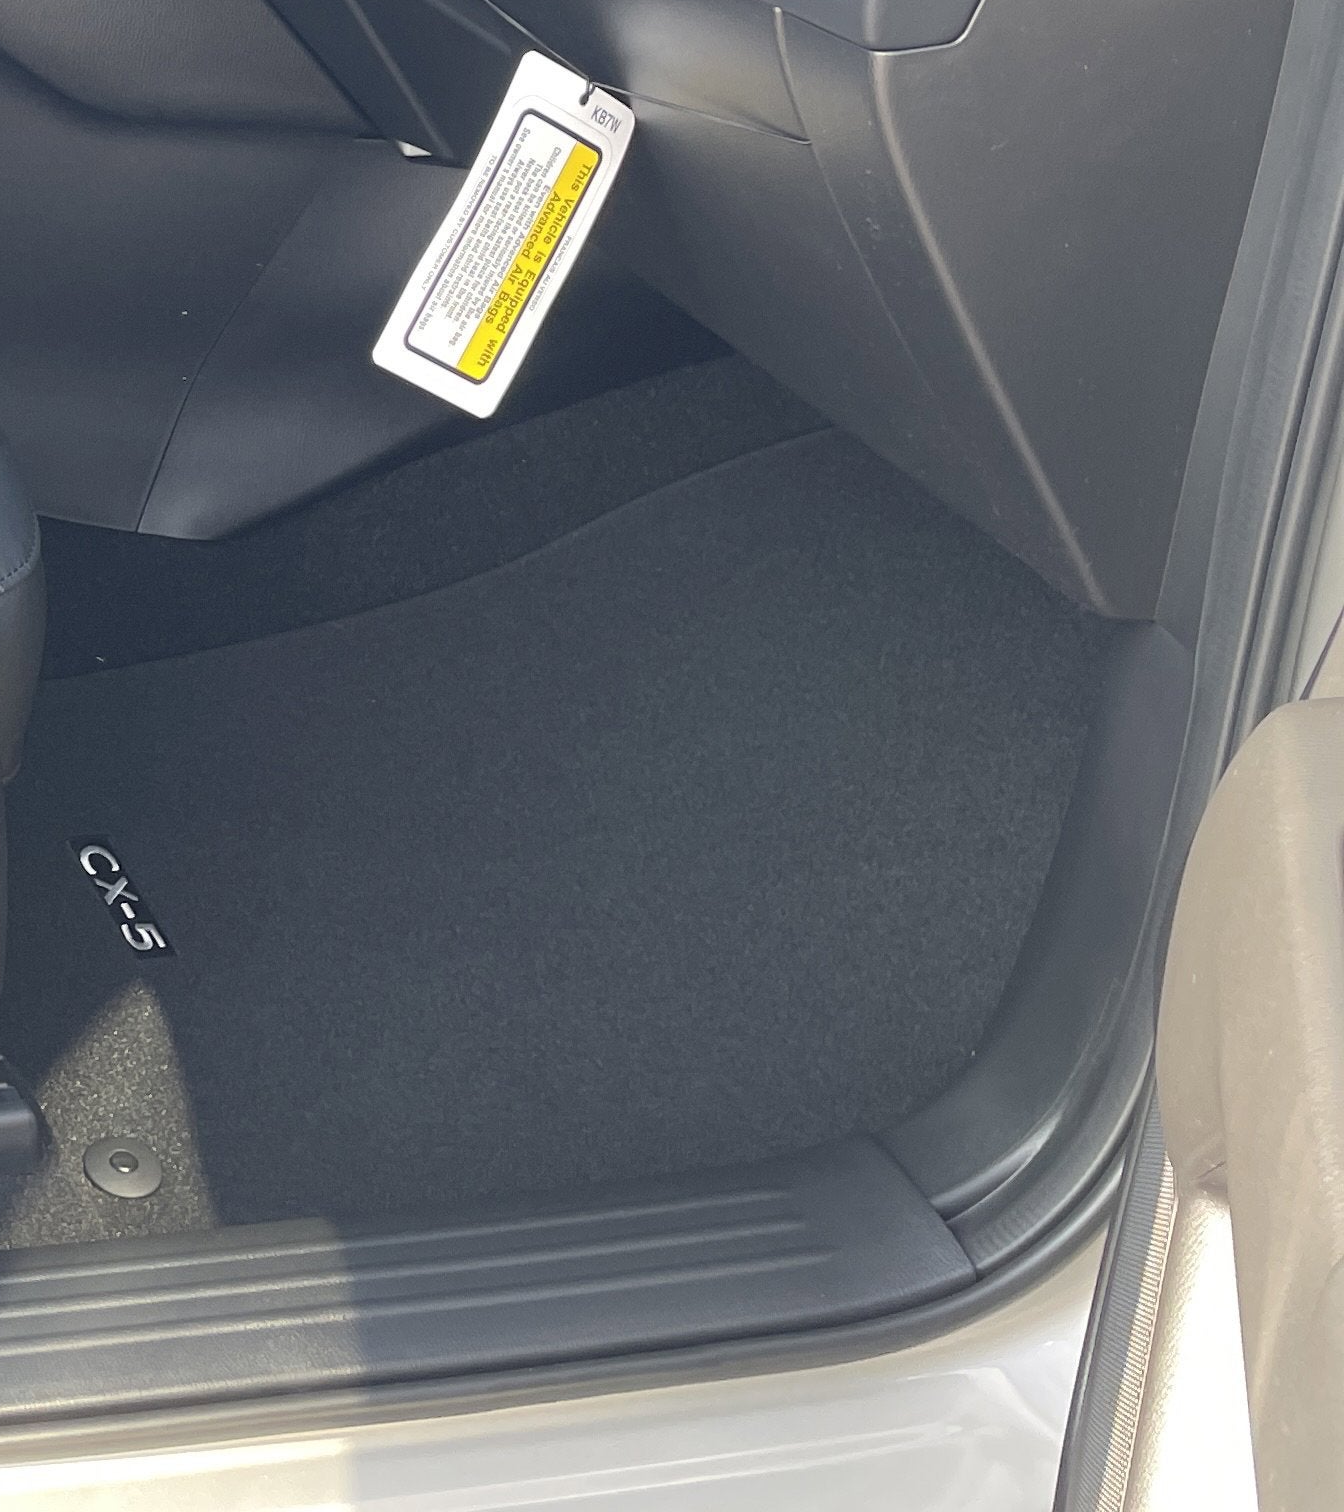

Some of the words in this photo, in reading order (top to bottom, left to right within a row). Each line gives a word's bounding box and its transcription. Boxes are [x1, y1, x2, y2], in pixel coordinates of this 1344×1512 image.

[569, 161, 593, 193] This
[533, 184, 550, 209] Even
[520, 190, 563, 259] Advanced
[522, 209, 537, 231] with
[541, 195, 575, 246] Vehicle
[496, 231, 525, 279] Advanced
[531, 249, 546, 264] is
[487, 278, 501, 295] Air
[506, 263, 524, 285] Air
[472, 294, 492, 320] Bags
[482, 288, 510, 326] Bags
[493, 267, 536, 334] Equipped
[476, 337, 500, 368] with
[79, 845, 167, 951] CX-5
